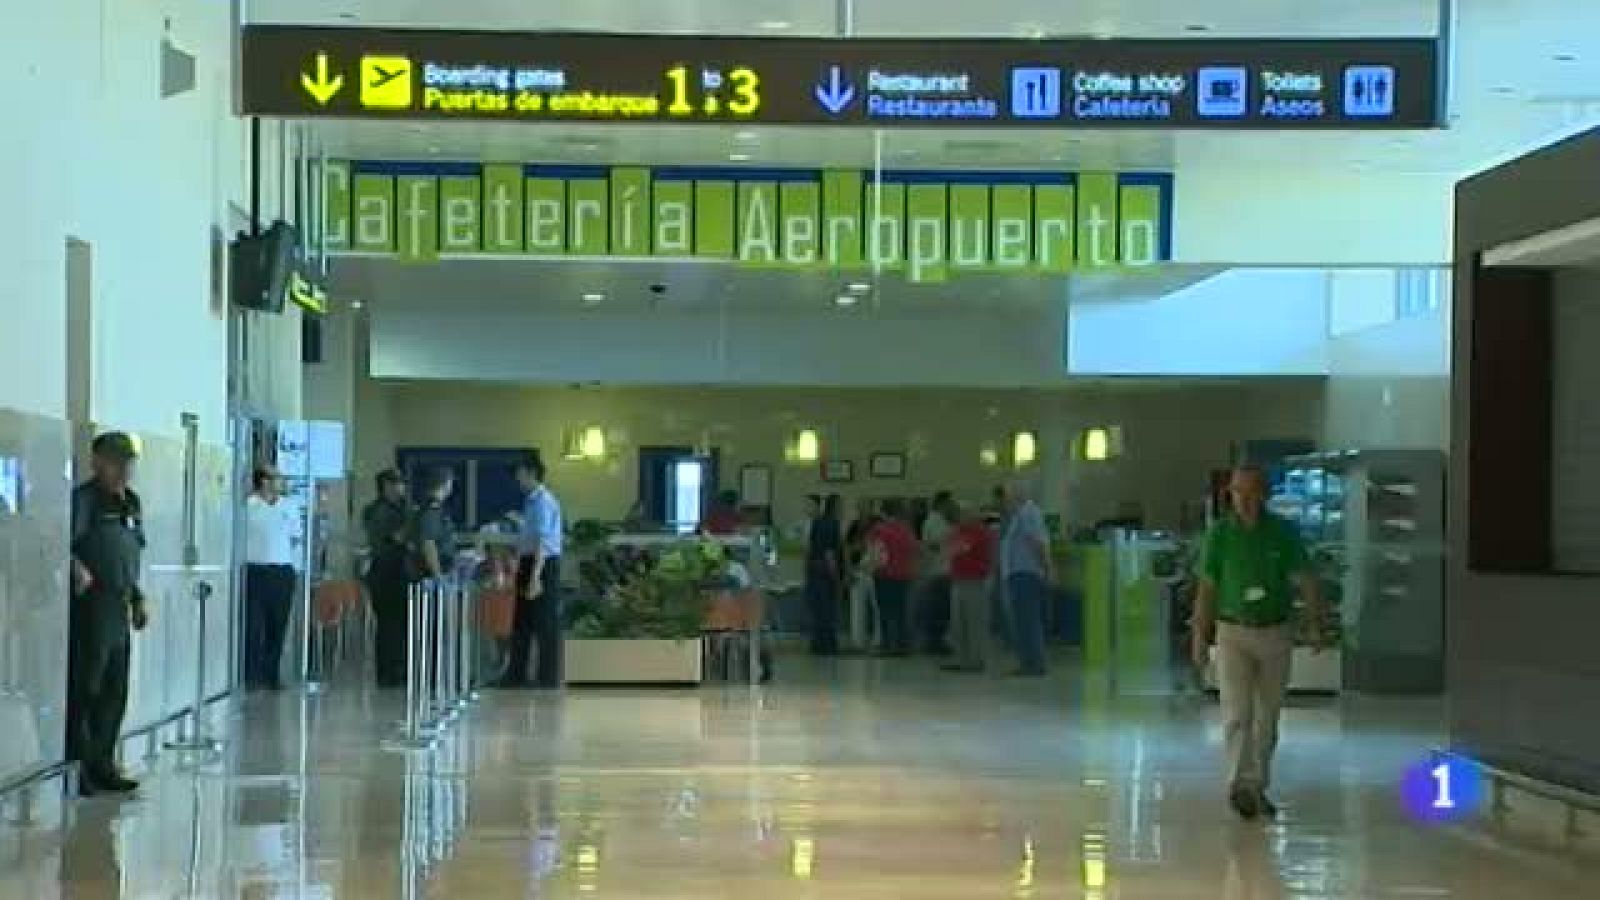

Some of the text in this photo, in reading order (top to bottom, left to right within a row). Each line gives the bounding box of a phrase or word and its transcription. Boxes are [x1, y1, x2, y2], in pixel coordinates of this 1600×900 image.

[665, 67, 691, 113] 1
[728, 67, 761, 114] 3
[867, 71, 969, 93] Restaurant
[1073, 73, 1185, 97] Coffee shop
[1262, 72, 1322, 93] Toilets
[423, 88, 658, 114] Puertas de embarque
[867, 94, 997, 117] Restaurante
[1260, 95, 1324, 117] Aseos
[318, 163, 1159, 282] Cafetería Aeropuerto
